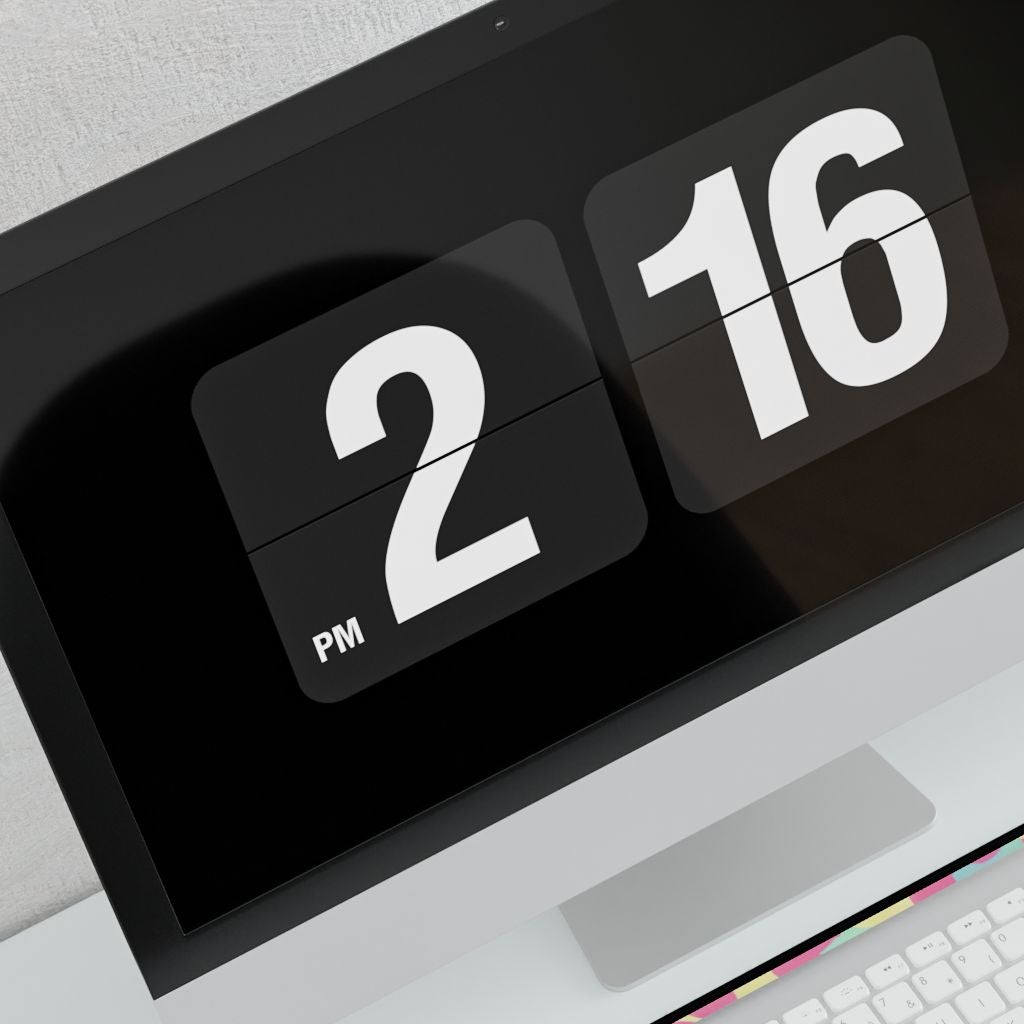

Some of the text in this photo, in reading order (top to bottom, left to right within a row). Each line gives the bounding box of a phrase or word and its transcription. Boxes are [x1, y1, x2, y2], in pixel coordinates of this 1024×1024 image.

[326, 108, 947, 624] 2 16
[312, 616, 365, 663] PM
[877, 996, 887, 1008] 7
[918, 975, 929, 986] 8
[957, 954, 967, 965] 9
